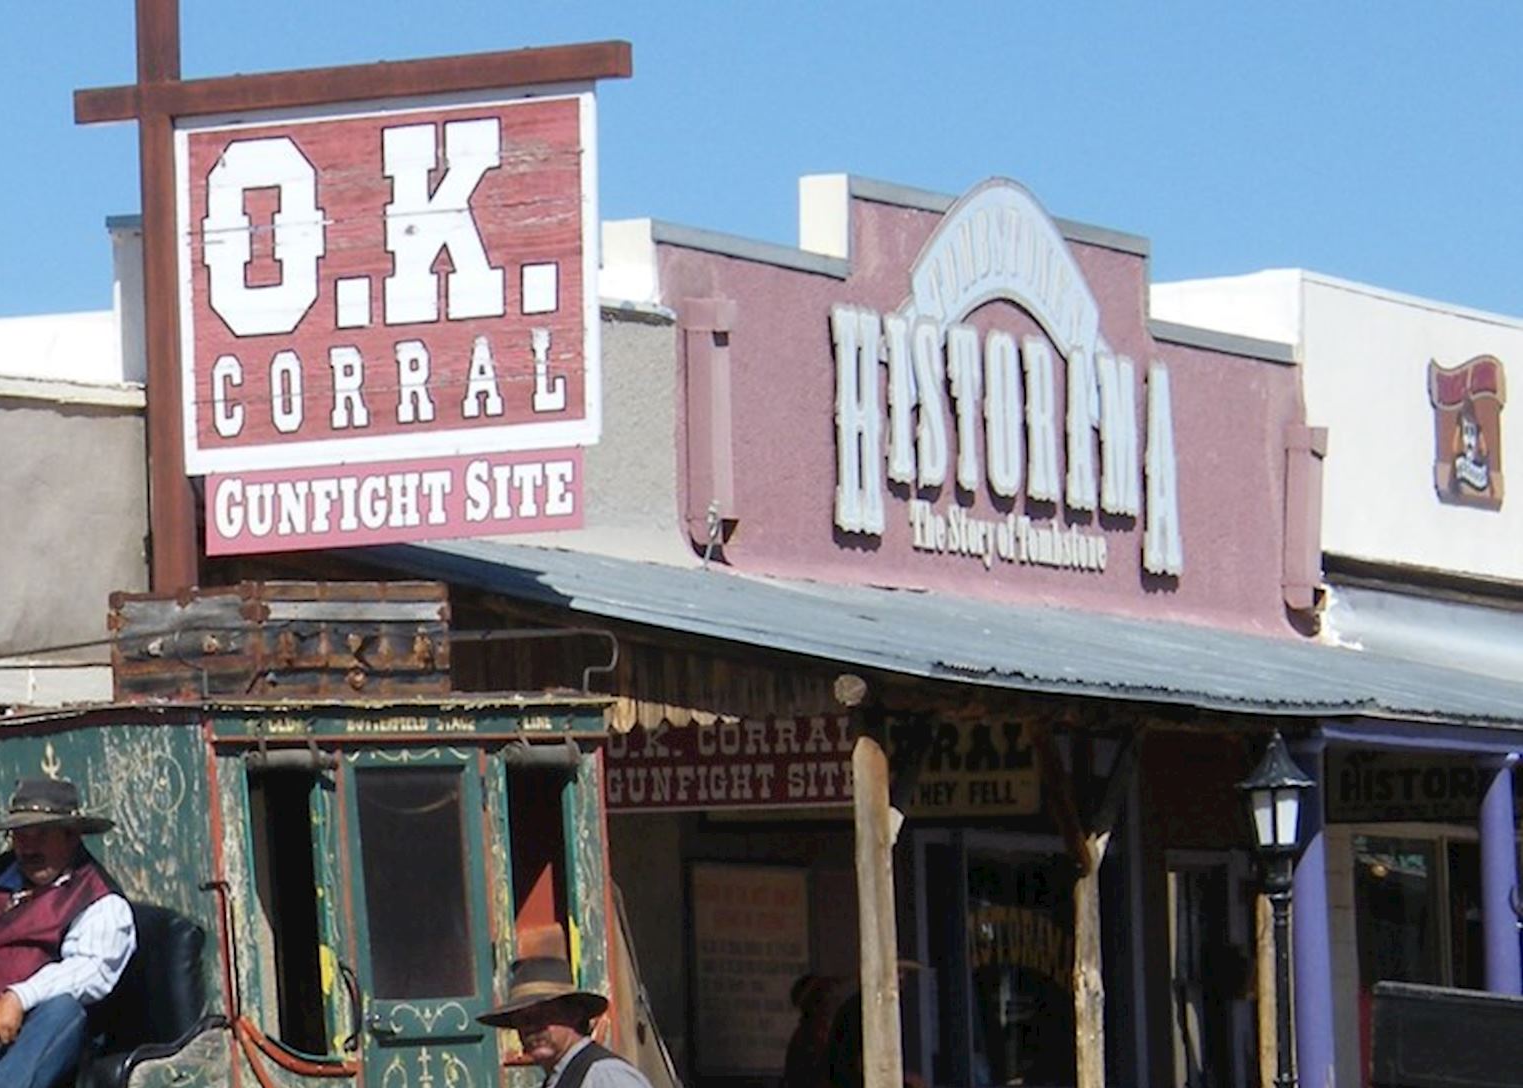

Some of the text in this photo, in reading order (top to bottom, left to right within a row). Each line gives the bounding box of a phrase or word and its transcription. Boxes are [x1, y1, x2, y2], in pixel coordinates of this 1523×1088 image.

[202, 117, 559, 338] O.K.
[211, 326, 566, 438] CORRAL
[830, 304, 1183, 577] HISTORAMA
[215, 458, 574, 539] GUNFIGHT SITE
[910, 498, 1108, 572] The Story of Tombstone
[345, 715, 429, 734] BUTTERFIELD
[697, 717, 854, 756] CORRAL
[606, 763, 775, 804] GUNFIGHT
